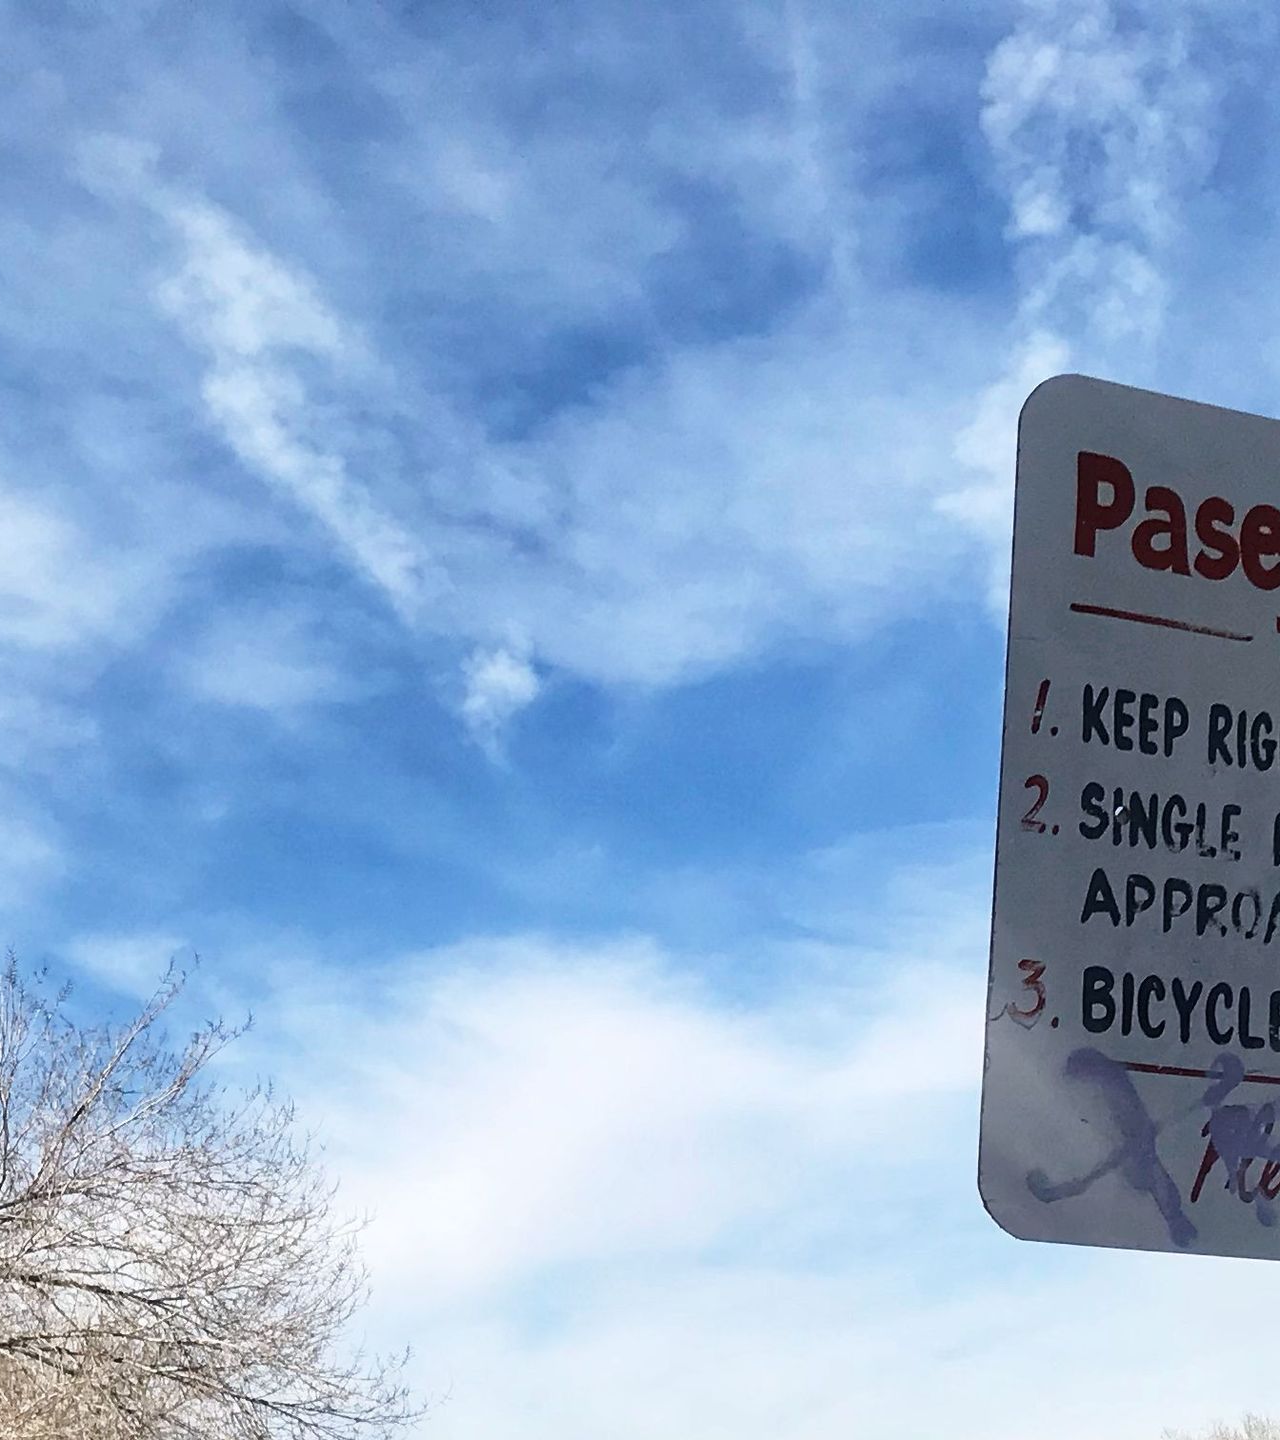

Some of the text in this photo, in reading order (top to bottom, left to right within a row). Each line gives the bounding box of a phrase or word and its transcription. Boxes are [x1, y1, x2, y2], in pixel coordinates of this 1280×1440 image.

[1030, 678, 1059, 737] 1.
[1081, 682, 1190, 758] KEEP
[1020, 773, 1061, 836] 2.
[1078, 781, 1242, 862] SINGLE
[1016, 958, 1060, 1028] 3.
